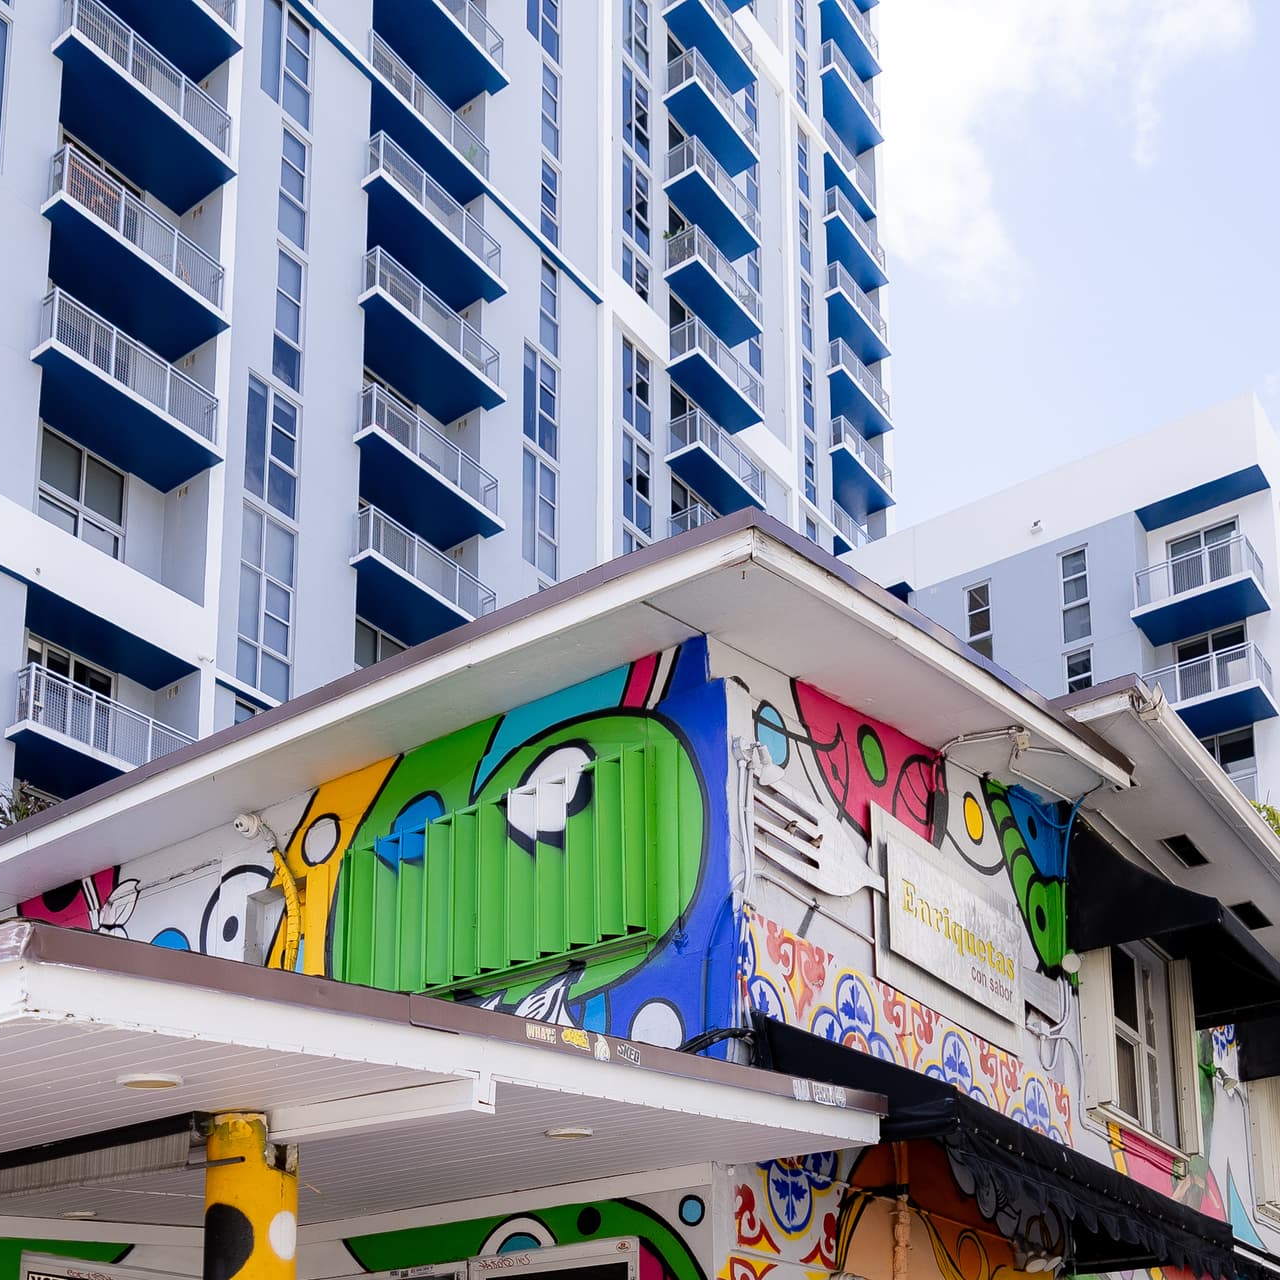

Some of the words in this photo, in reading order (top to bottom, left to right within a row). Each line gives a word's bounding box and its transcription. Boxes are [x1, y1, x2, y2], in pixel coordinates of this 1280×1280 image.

[902, 878, 1015, 981] Enriquetas
[971, 966, 988, 988] con
[990, 975, 1013, 1004] sabor
